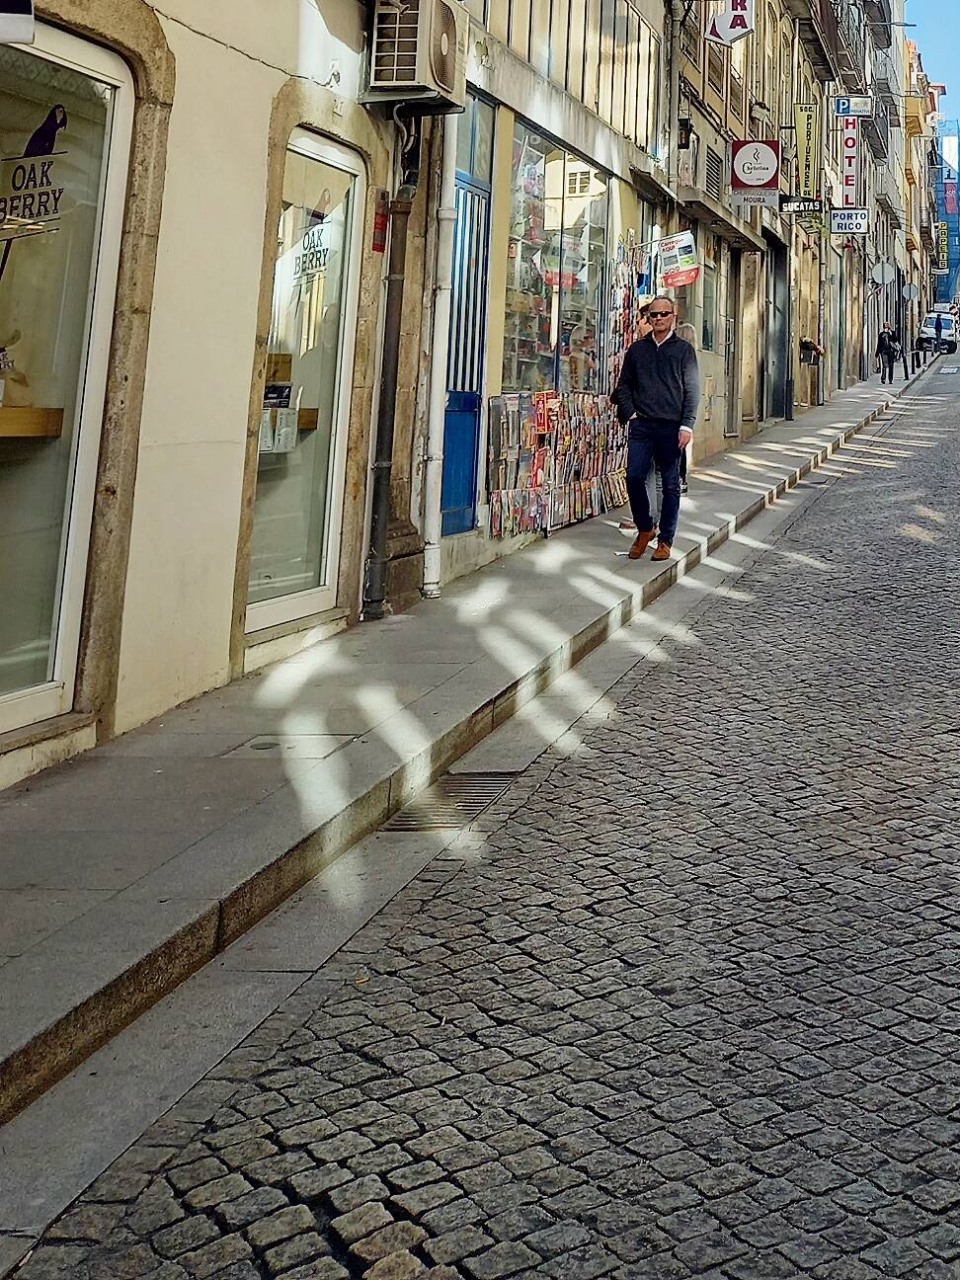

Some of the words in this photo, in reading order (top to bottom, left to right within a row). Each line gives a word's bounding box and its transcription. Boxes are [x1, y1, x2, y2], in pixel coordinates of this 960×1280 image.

[839, 99, 849, 113] P
[804, 114, 813, 188] PORTUENSE
[844, 118, 857, 206] HOTEL
[12, 160, 54, 191] OAK
[782, 201, 820, 212] SUCATAS
[832, 212, 867, 221] PORTO
[837, 222, 862, 231] RICO
[302, 228, 324, 252] OAK
[293, 247, 329, 276] BERRY
